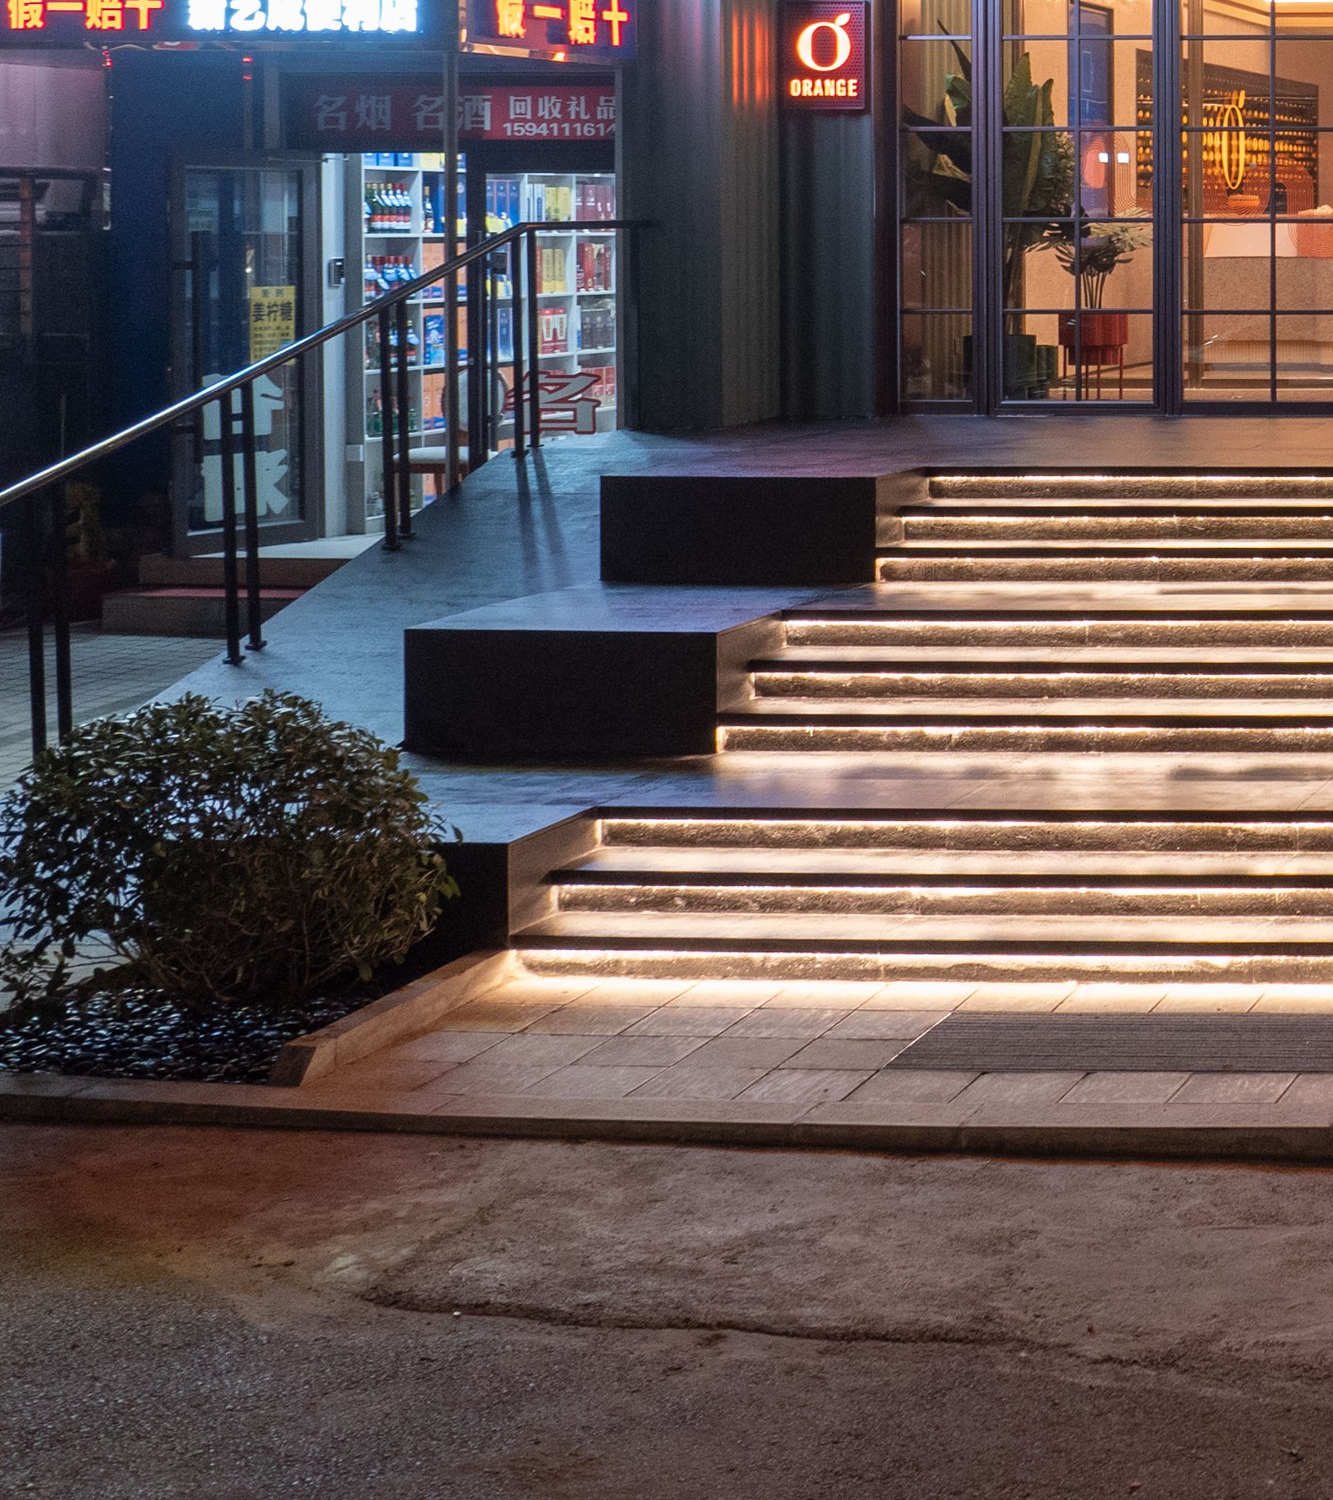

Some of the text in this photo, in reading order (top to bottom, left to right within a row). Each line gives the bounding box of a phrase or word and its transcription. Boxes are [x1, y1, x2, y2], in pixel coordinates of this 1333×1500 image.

[790, 78, 858, 97] ORANGE
[509, 95, 615, 120] 回收礼品
